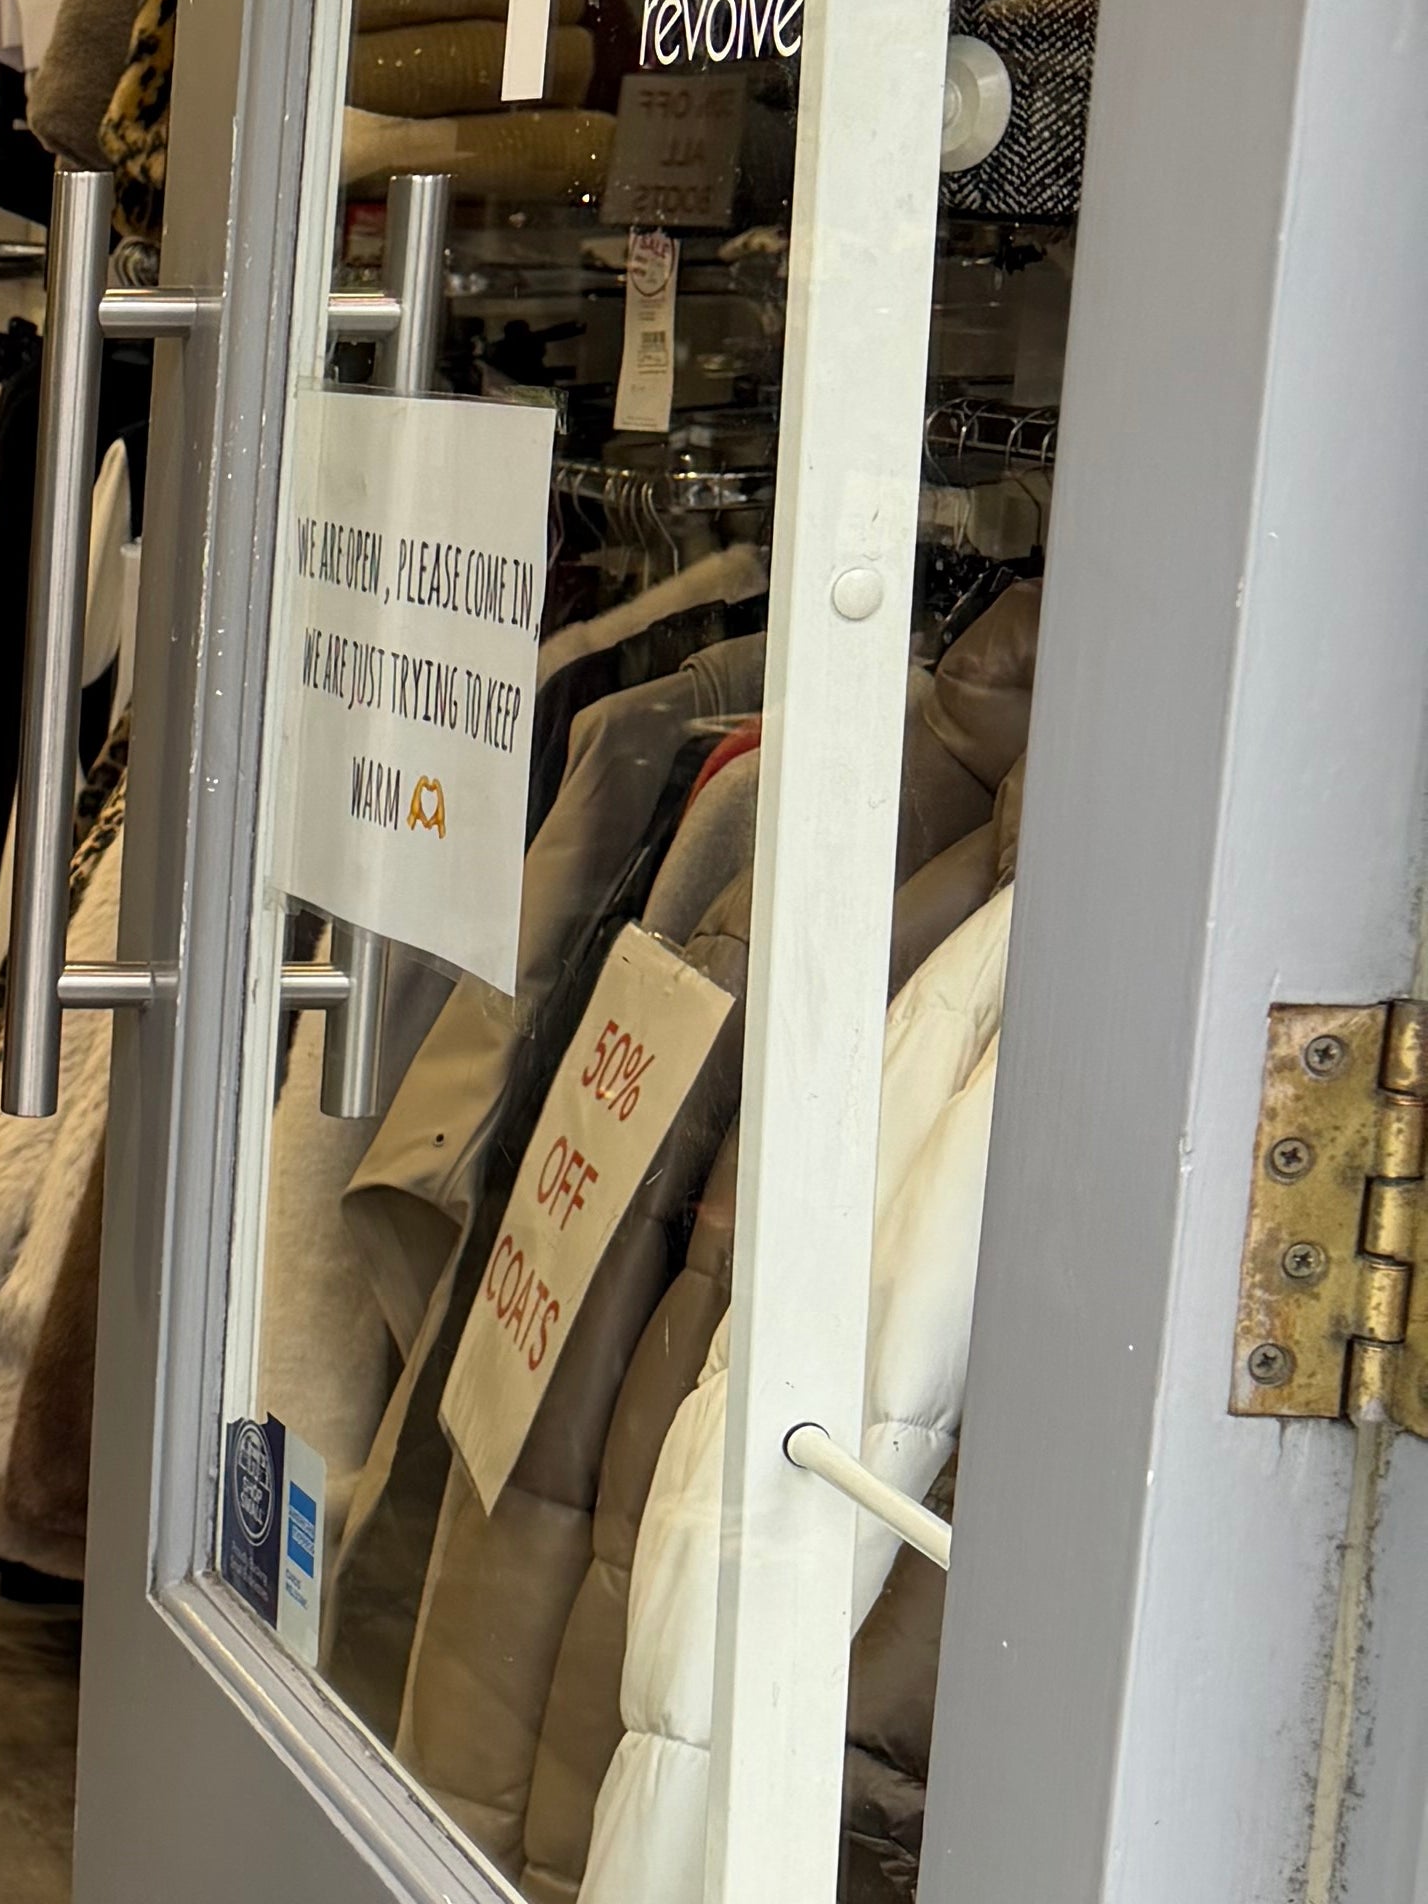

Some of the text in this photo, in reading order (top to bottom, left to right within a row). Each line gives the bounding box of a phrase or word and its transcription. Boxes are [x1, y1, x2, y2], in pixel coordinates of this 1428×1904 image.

[297, 516, 317, 579] WE
[319, 520, 345, 586] ARE
[396, 537, 462, 612] PLEASE
[465, 548, 508, 624] COME
[302, 626, 522, 754] WE ARE JUST TRYING TO KEEP
[350, 755, 402, 832] WARM
[581, 1018, 657, 1123] 50%
[535, 1134, 599, 1232] OFF
[484, 1234, 561, 1372] COATS
